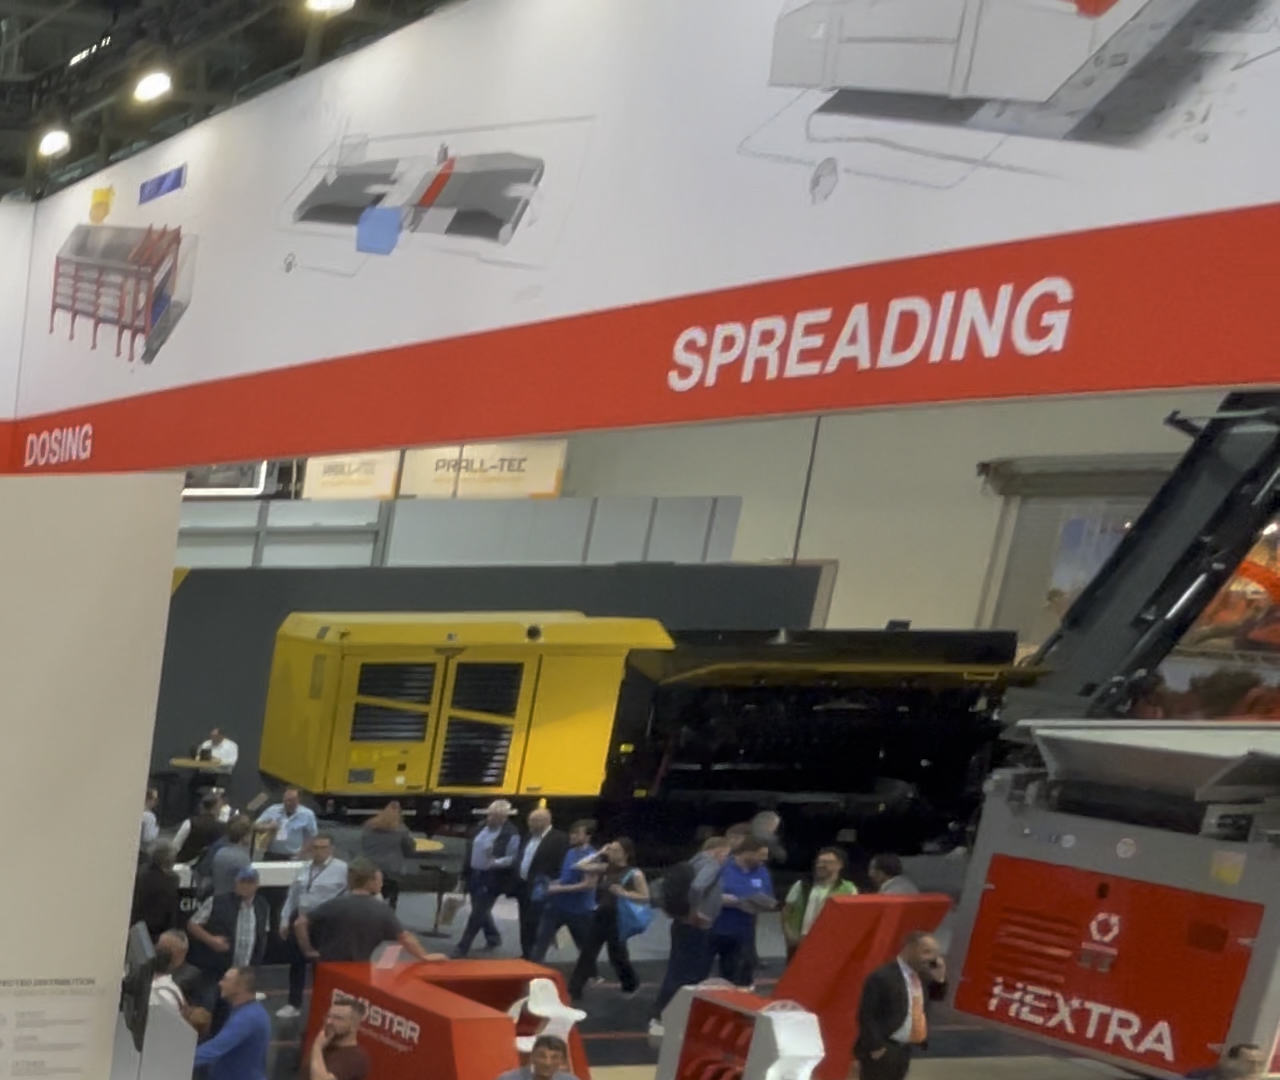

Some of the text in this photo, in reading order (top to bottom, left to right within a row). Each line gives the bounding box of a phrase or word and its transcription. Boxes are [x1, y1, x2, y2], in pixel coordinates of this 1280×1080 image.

[668, 277, 1074, 392] SPREADING
[24, 423, 93, 467] DOSING
[987, 976, 1175, 1062] HEXTRA
